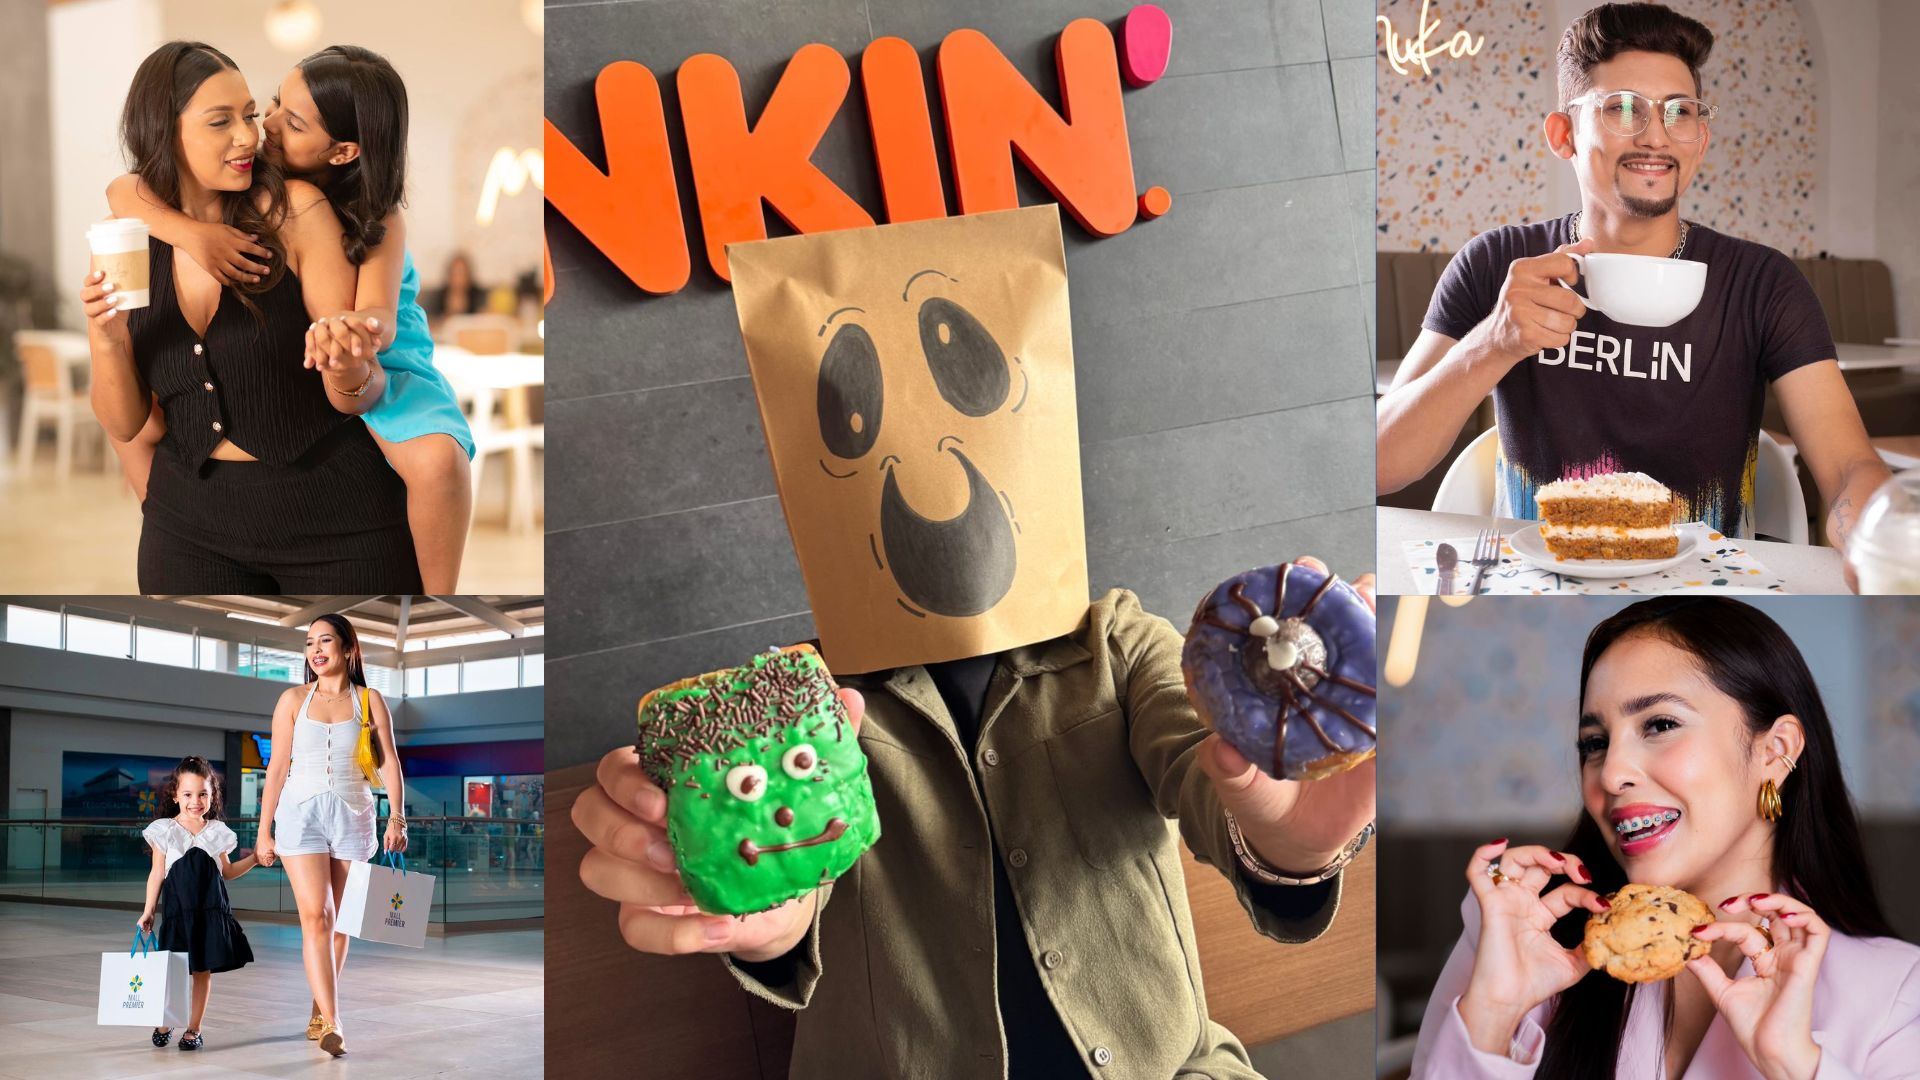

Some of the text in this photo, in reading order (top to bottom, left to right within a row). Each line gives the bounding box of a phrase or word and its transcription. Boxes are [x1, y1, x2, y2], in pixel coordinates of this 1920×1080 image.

[389, 911, 401, 920] MALL
[384, 918, 406, 928] PREMIER
[122, 1001, 144, 1009] PREMIER
